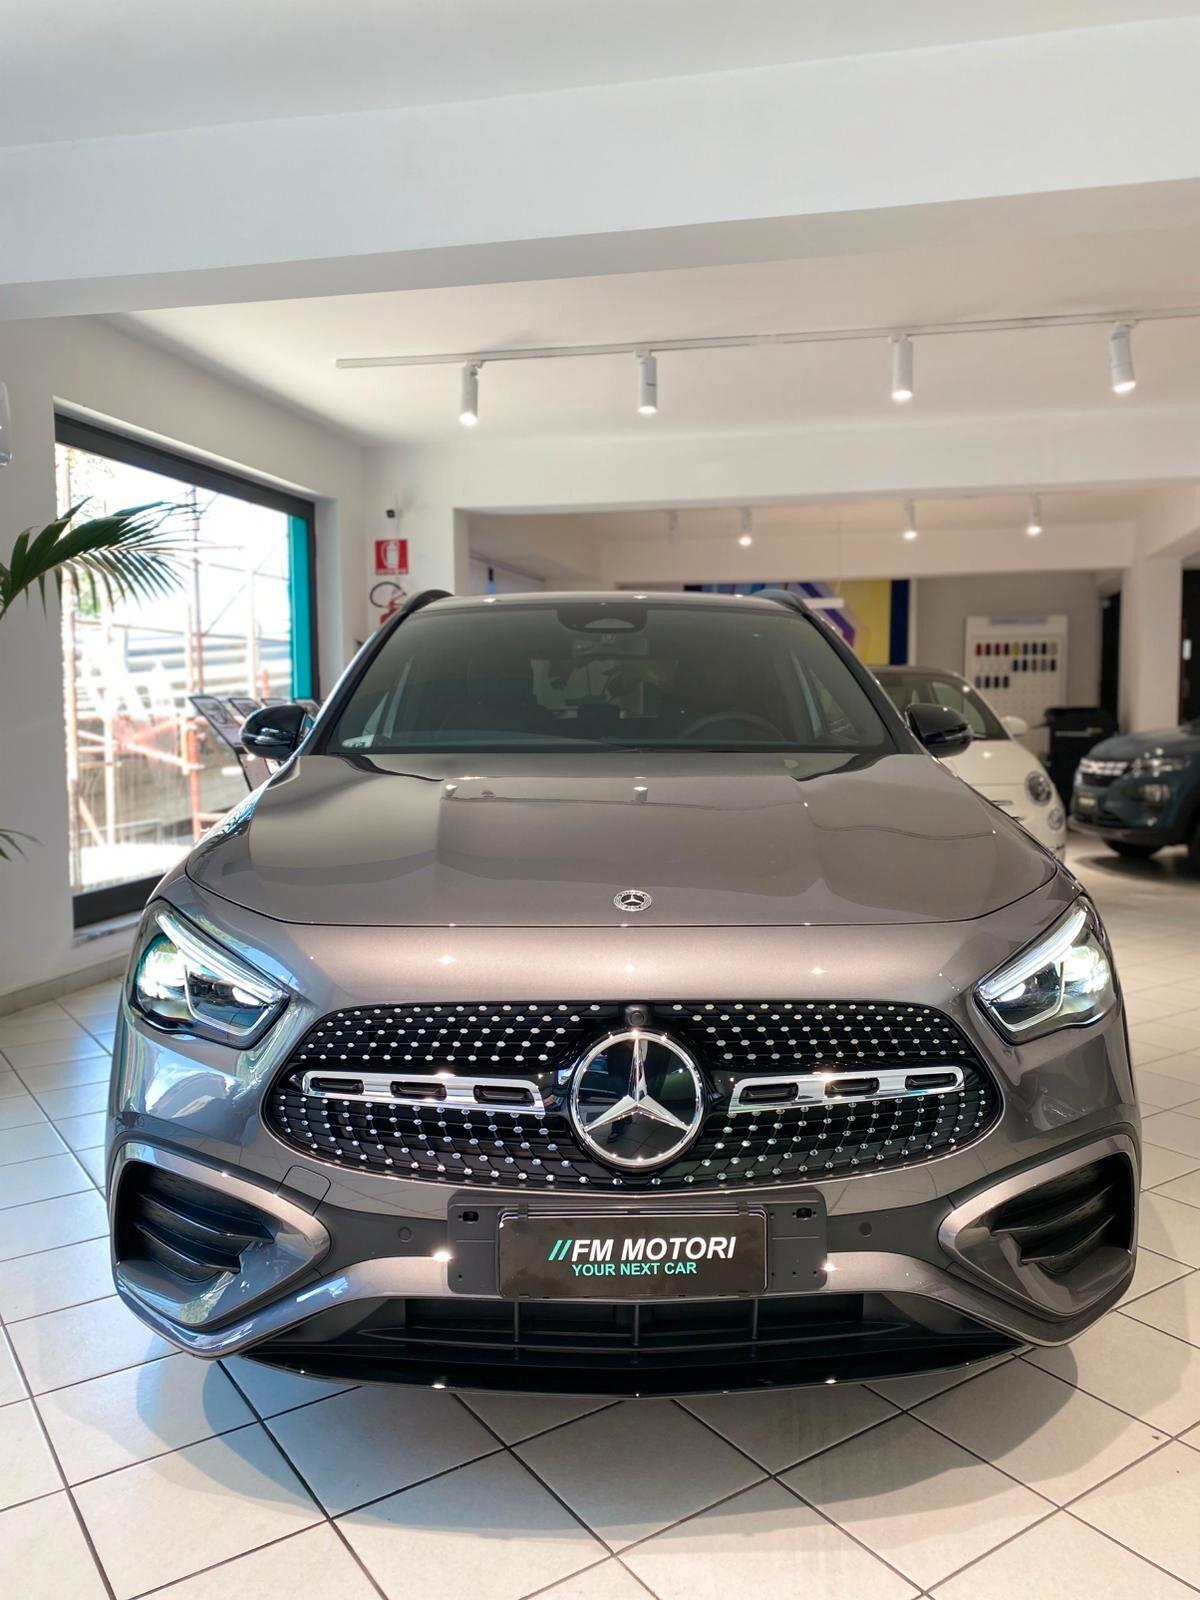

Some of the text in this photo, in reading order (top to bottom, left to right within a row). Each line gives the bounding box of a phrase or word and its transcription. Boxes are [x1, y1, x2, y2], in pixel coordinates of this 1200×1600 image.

[621, 1236, 737, 1261] MOTORI
[572, 1261, 697, 1277] YOUR NEXT CAR
